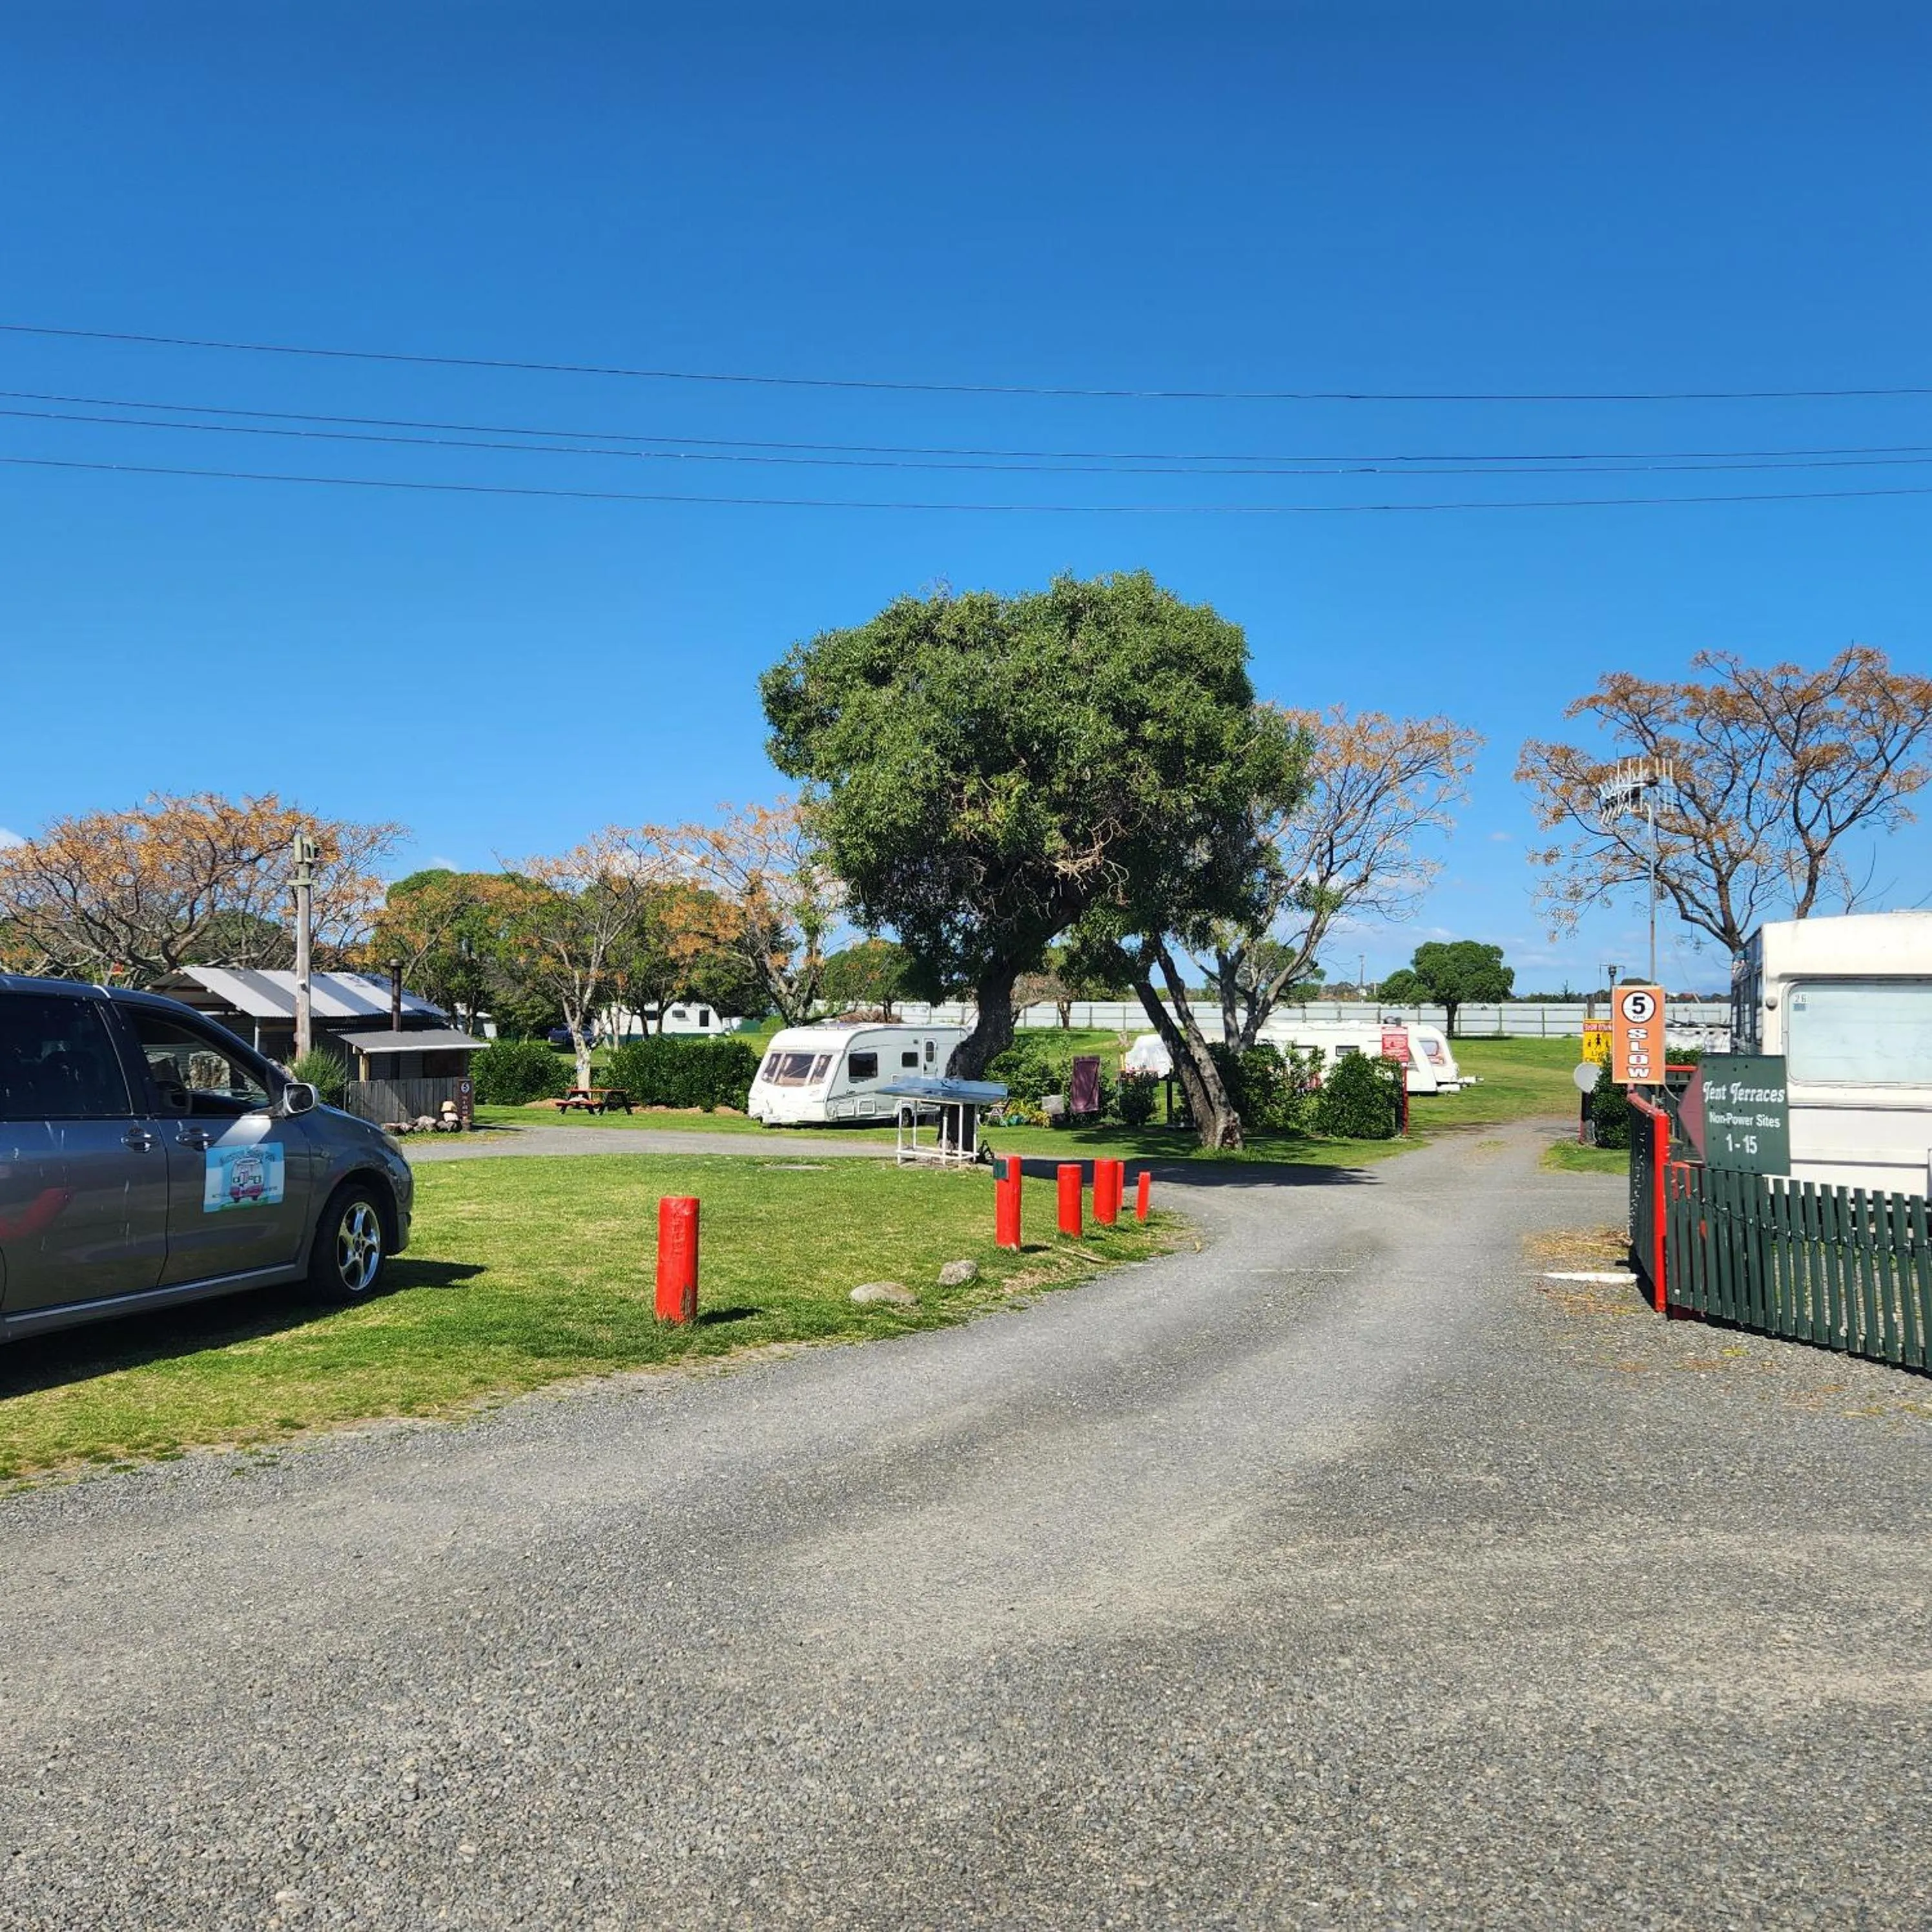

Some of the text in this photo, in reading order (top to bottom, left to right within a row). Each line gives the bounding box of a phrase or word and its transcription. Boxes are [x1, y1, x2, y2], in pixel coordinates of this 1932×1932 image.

[1632, 996, 1645, 1014] 5
[1627, 1027, 1650, 1078] SLOW
[1703, 1080, 1785, 1105] Tent Terraces
[1709, 1111, 1781, 1128] Non-Power Sites
